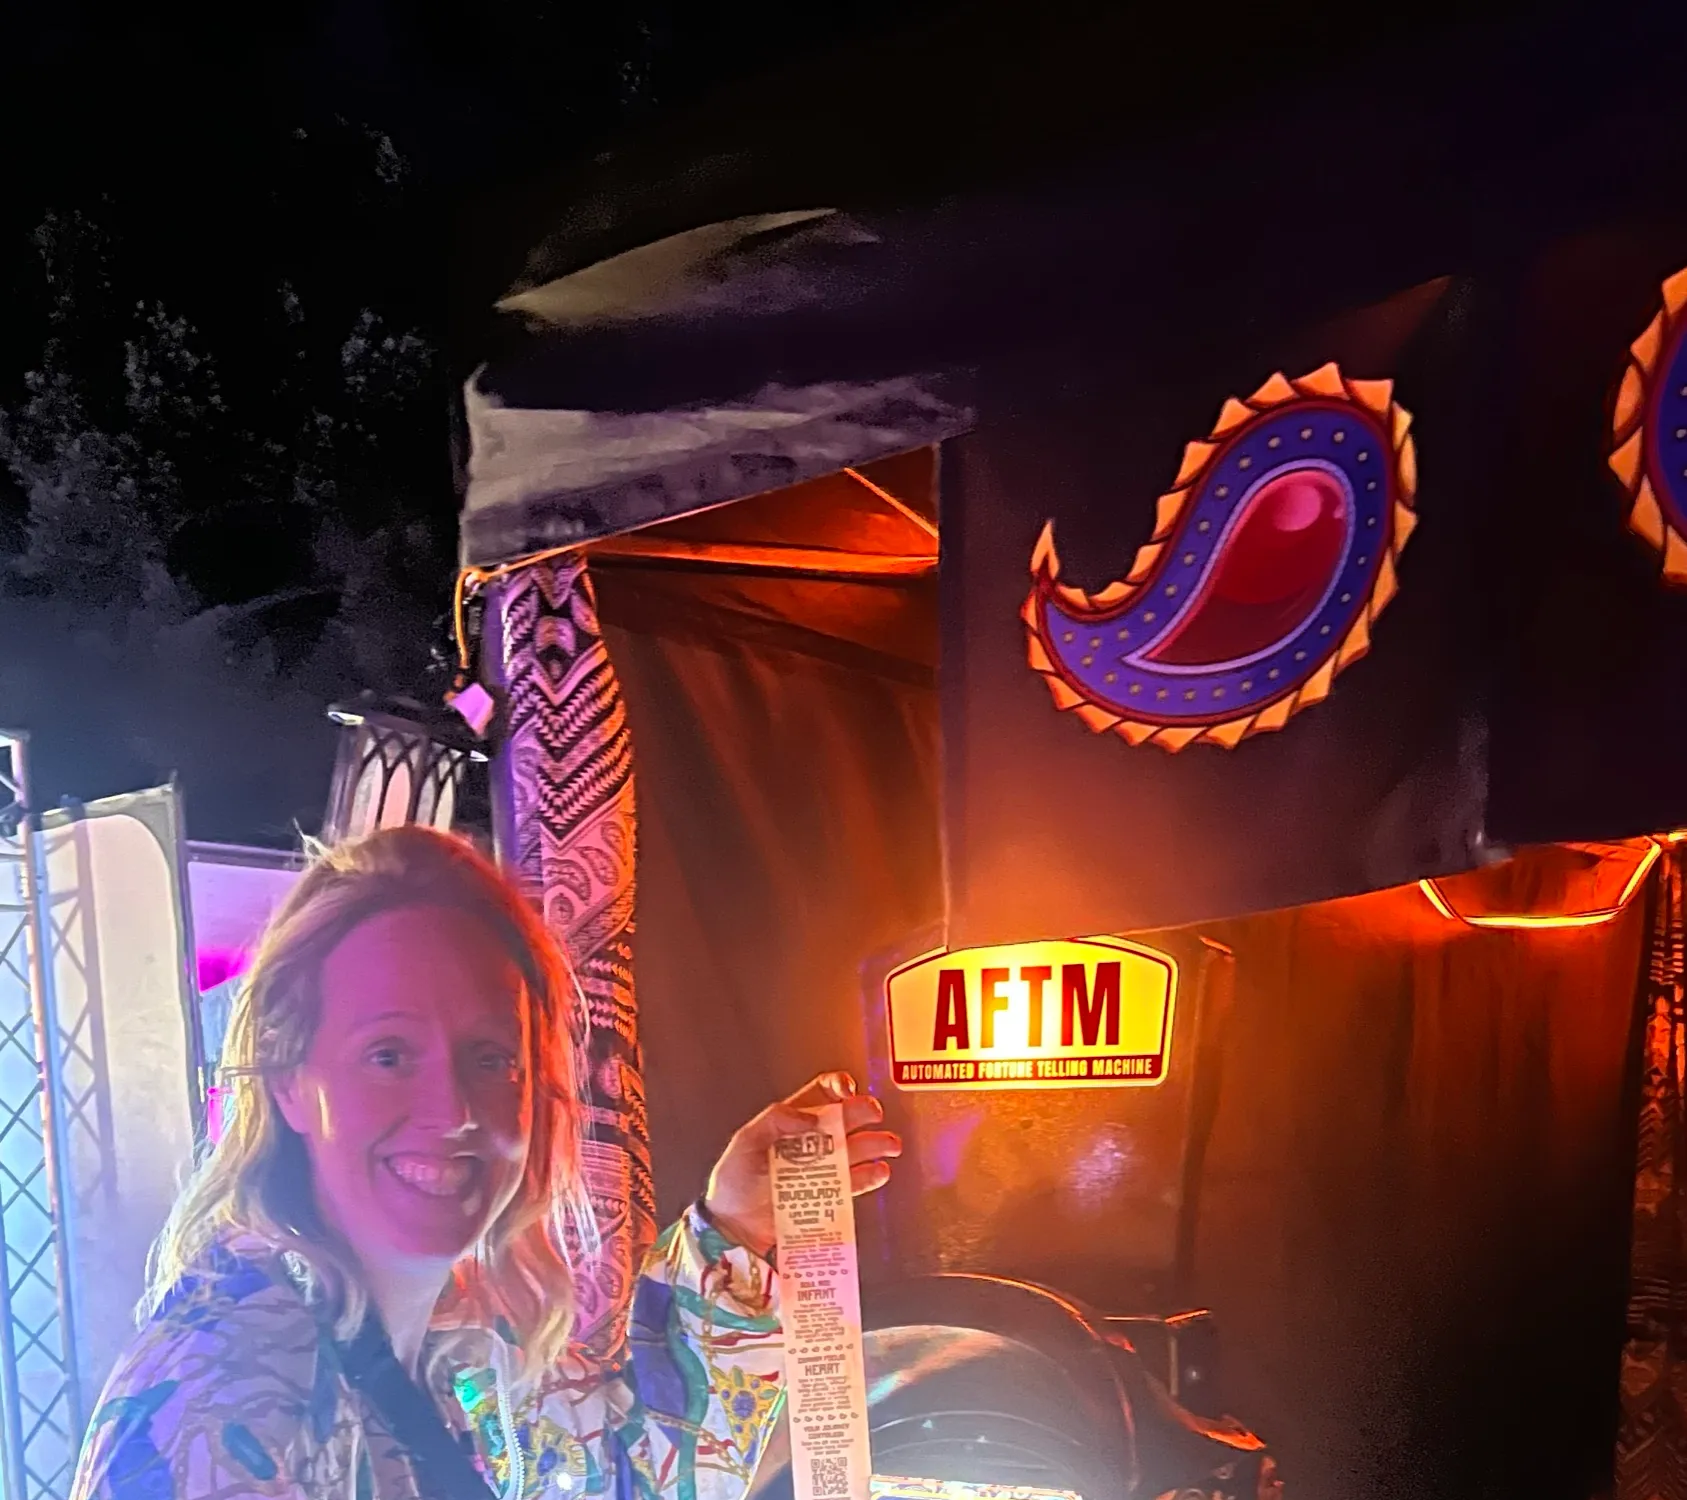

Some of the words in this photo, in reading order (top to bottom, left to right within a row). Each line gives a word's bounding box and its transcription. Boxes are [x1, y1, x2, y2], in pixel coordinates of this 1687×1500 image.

[932, 961, 1122, 1052] AFTM
[902, 1062, 975, 1081] AUTOMATED
[978, 1061, 1033, 1079] FORTUNE
[1037, 1060, 1087, 1078] TELLING
[1092, 1058, 1153, 1076] MACHINE
[778, 1187, 841, 1203] RIVERLADY
[824, 1209, 835, 1223] 4
[797, 1287, 837, 1302] INFANT
[804, 1362, 841, 1377] HEART
